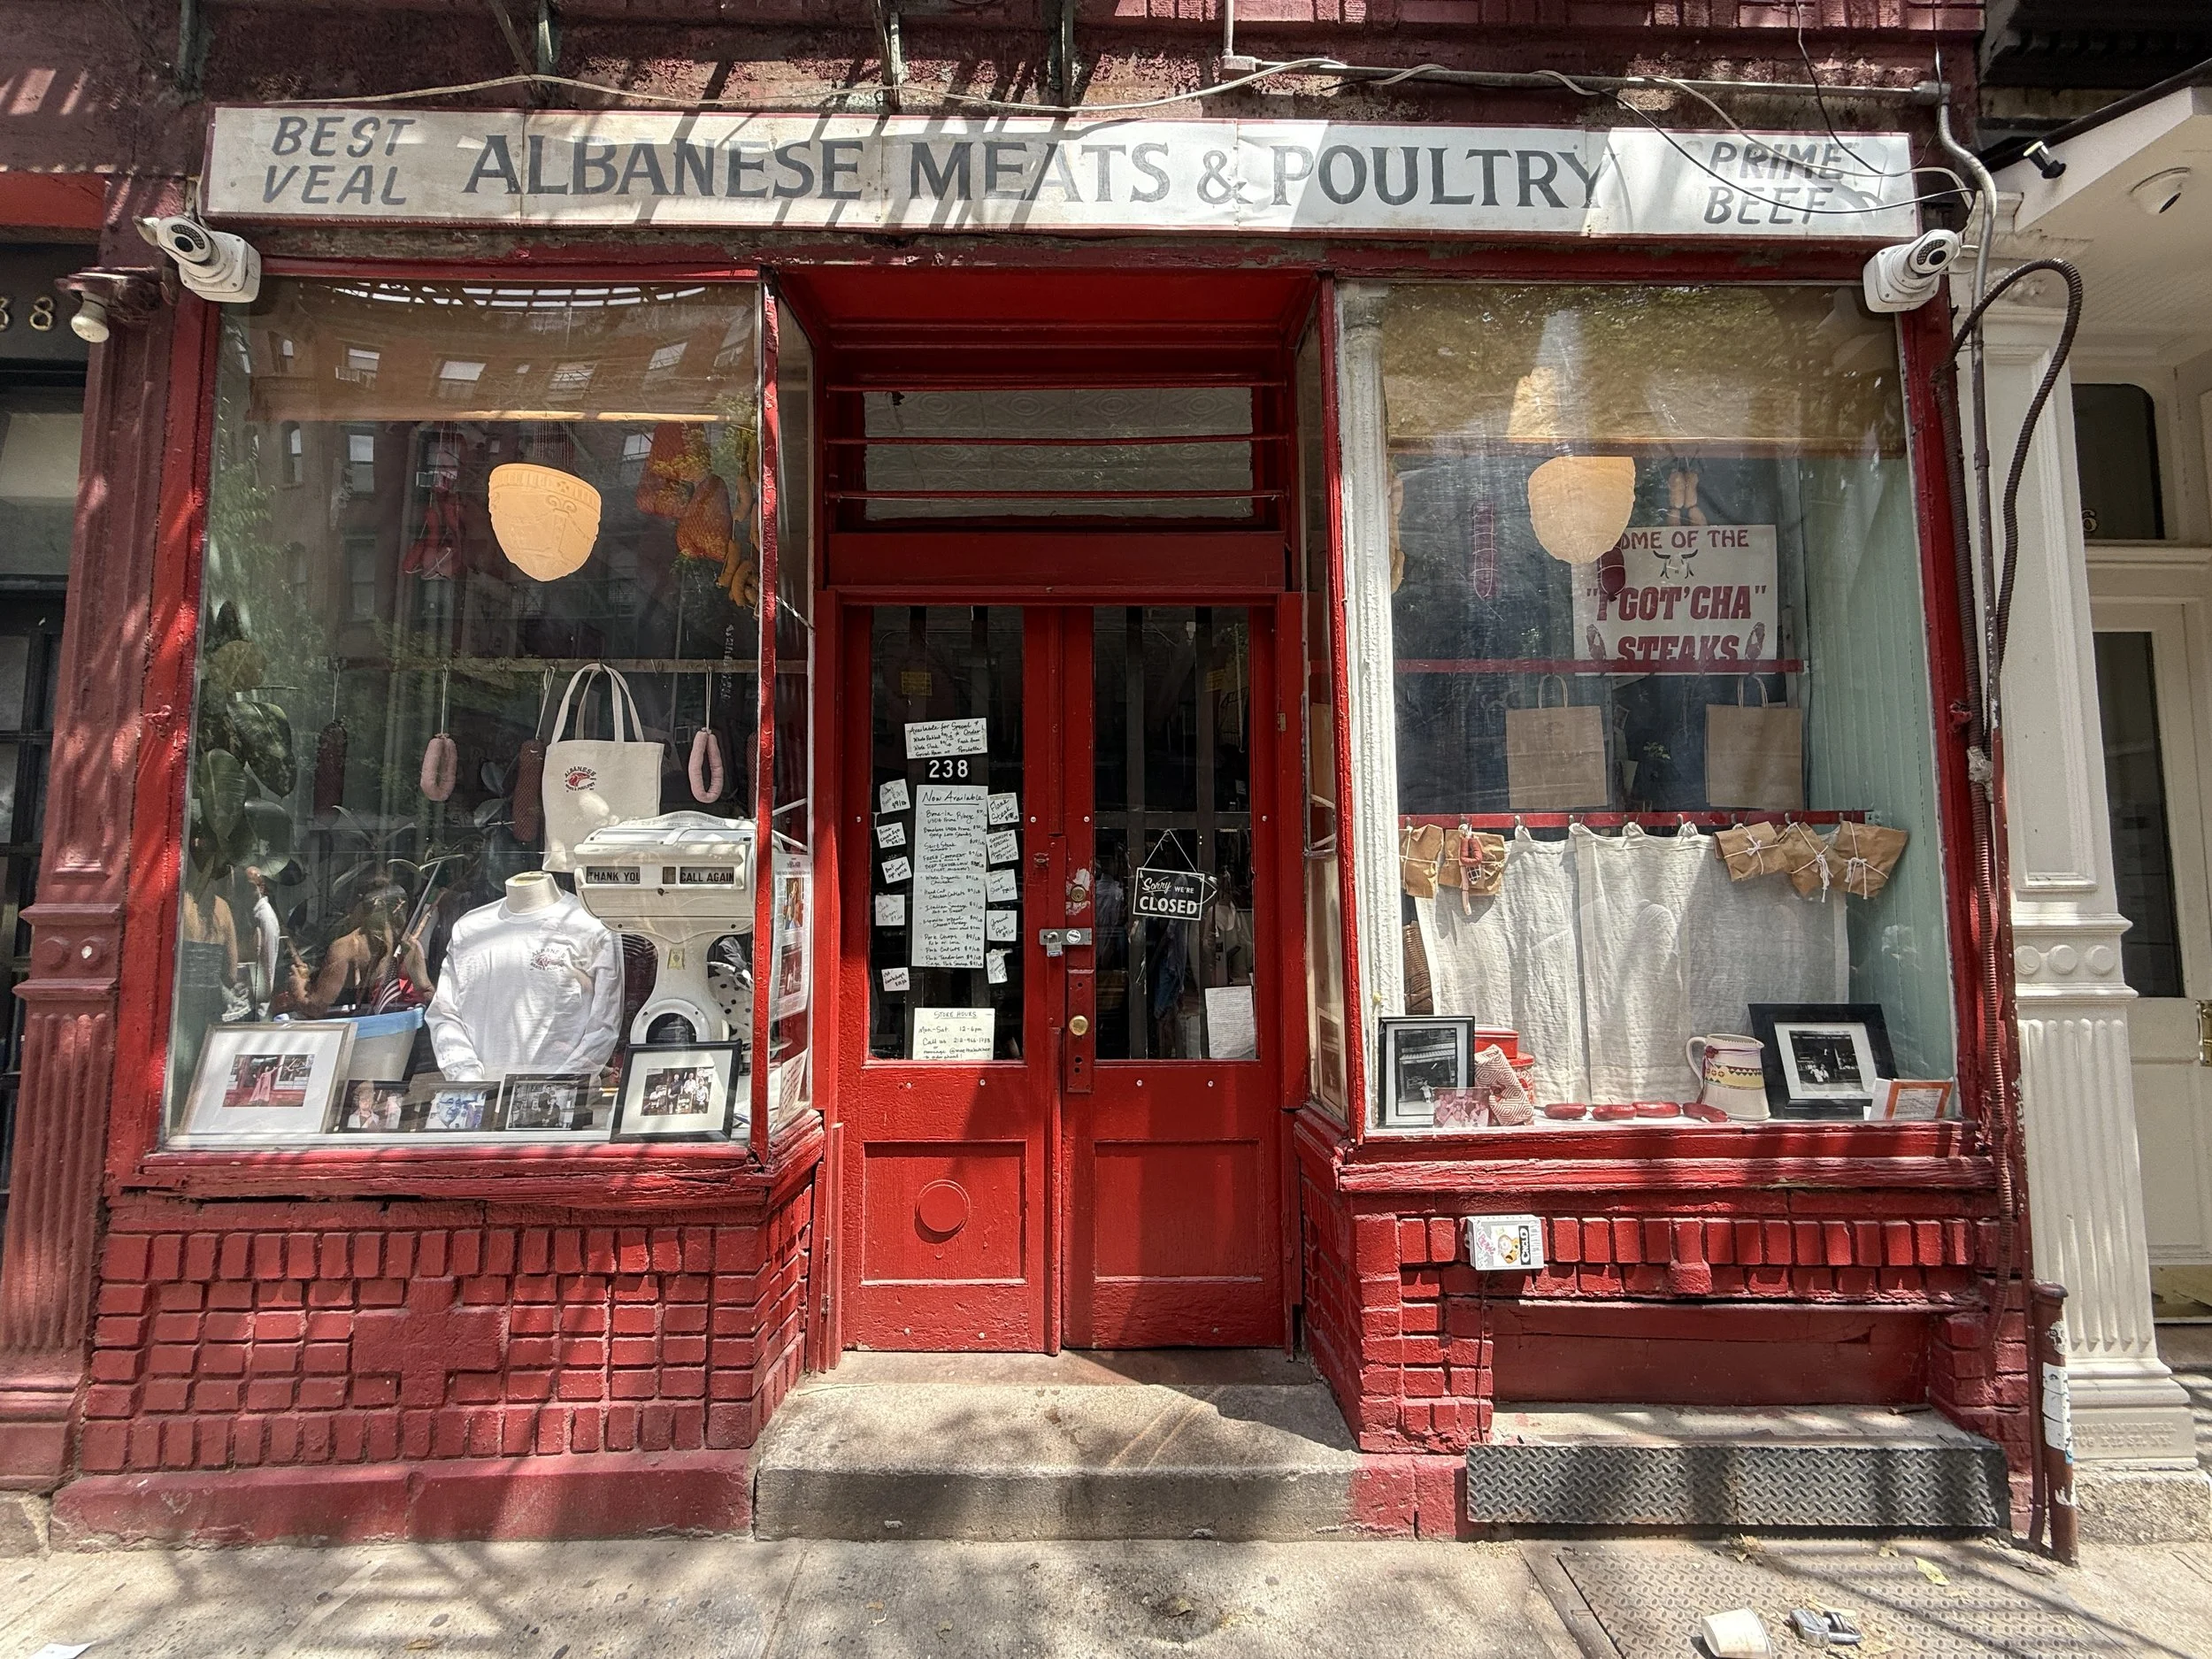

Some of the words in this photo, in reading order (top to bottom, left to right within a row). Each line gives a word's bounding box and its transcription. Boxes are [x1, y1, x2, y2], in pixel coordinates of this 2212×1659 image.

[272, 116, 416, 157] BEST
[1708, 142, 1854, 180] PRIME
[461, 134, 864, 201] ALBANESE
[910, 141, 1171, 203] MEATS
[1196, 149, 1254, 206] &
[1271, 143, 1620, 209] POULTRY
[263, 165, 408, 205] VEAL
[1703, 186, 1834, 224] BEEF
[1620, 530, 1663, 549] OME
[1671, 530, 1699, 549] OF
[1707, 529, 1750, 548] THE
[1617, 635, 1740, 661] STEAKS
[928, 759, 968, 779] 238
[922, 789, 941, 803] Now
[944, 790, 984, 803] Available
[990, 799, 1010, 812] Flank
[991, 806, 1013, 823] Steak
[588, 870, 619, 882] THANK
[680, 870, 703, 882] CALL
[706, 870, 734, 882] AGAIN
[1141, 877, 1172, 895] Sorry
[1174, 886, 1195, 895] WE'RE
[1139, 895, 1198, 915] CLOSED
[923, 1037, 937, 1046] Call
